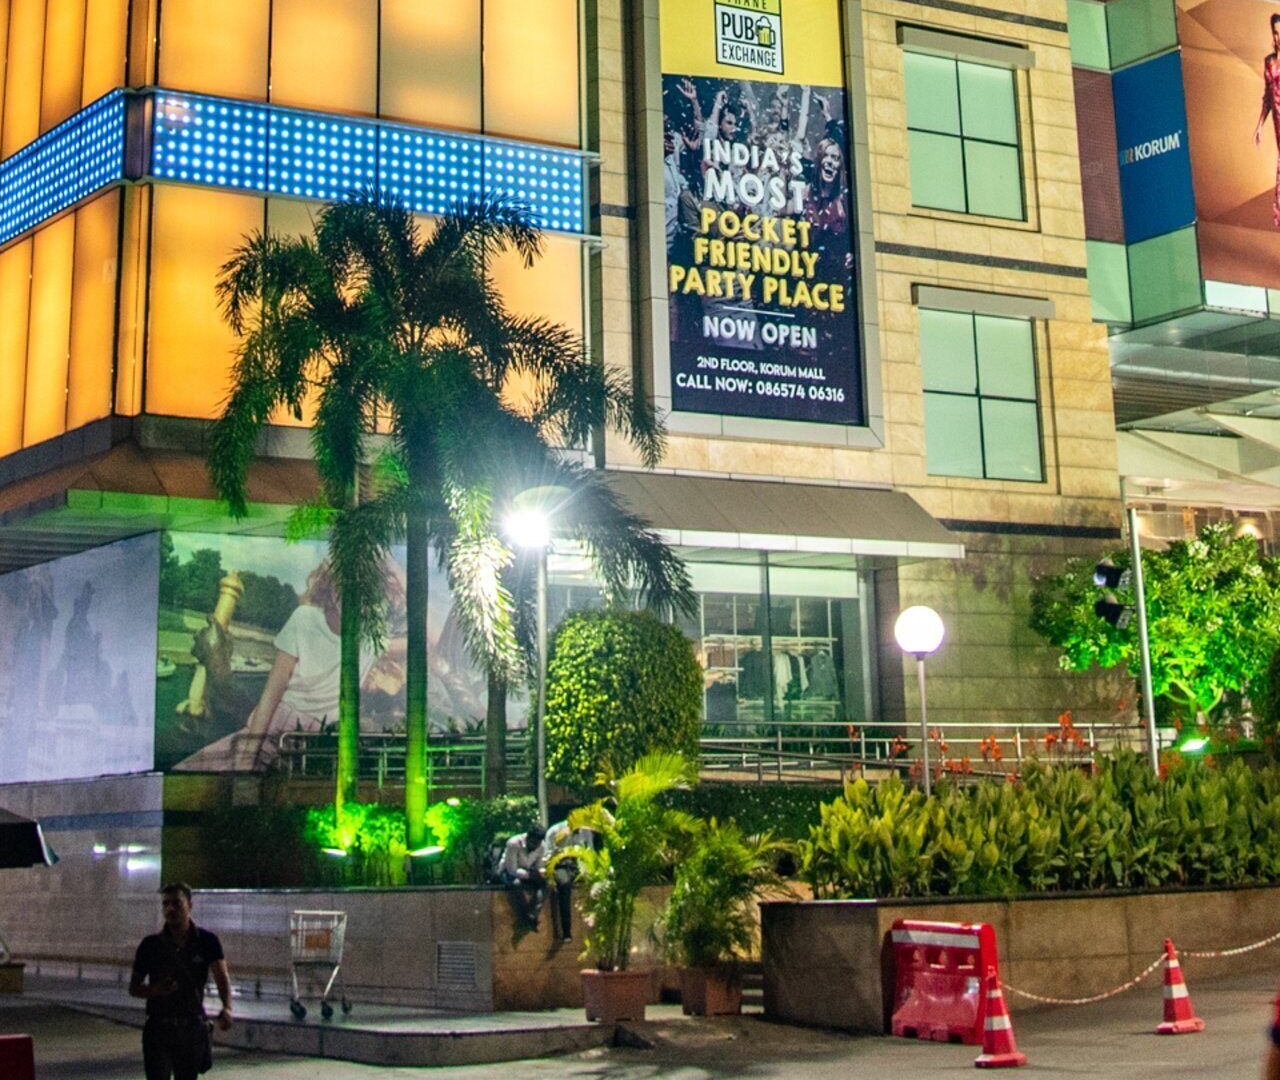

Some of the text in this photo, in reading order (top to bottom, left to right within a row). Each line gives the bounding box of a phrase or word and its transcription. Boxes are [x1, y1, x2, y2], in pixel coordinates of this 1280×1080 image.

[721, 11, 755, 41] PUB
[722, 42, 777, 68] EXCHANGE
[704, 137, 804, 174] INDIA'S
[1134, 132, 1180, 162] KORUM
[704, 168, 808, 212] MOST
[700, 207, 811, 248] POCKET
[694, 237, 819, 278] FRIENDLY
[670, 265, 845, 312] PARTY PLACE
[703, 316, 817, 349] NOW OPEN
[697, 356, 826, 380] 2ND FLOOR, KORUM MALL
[676, 373, 845, 402] CALL NOW: 086574 06316
